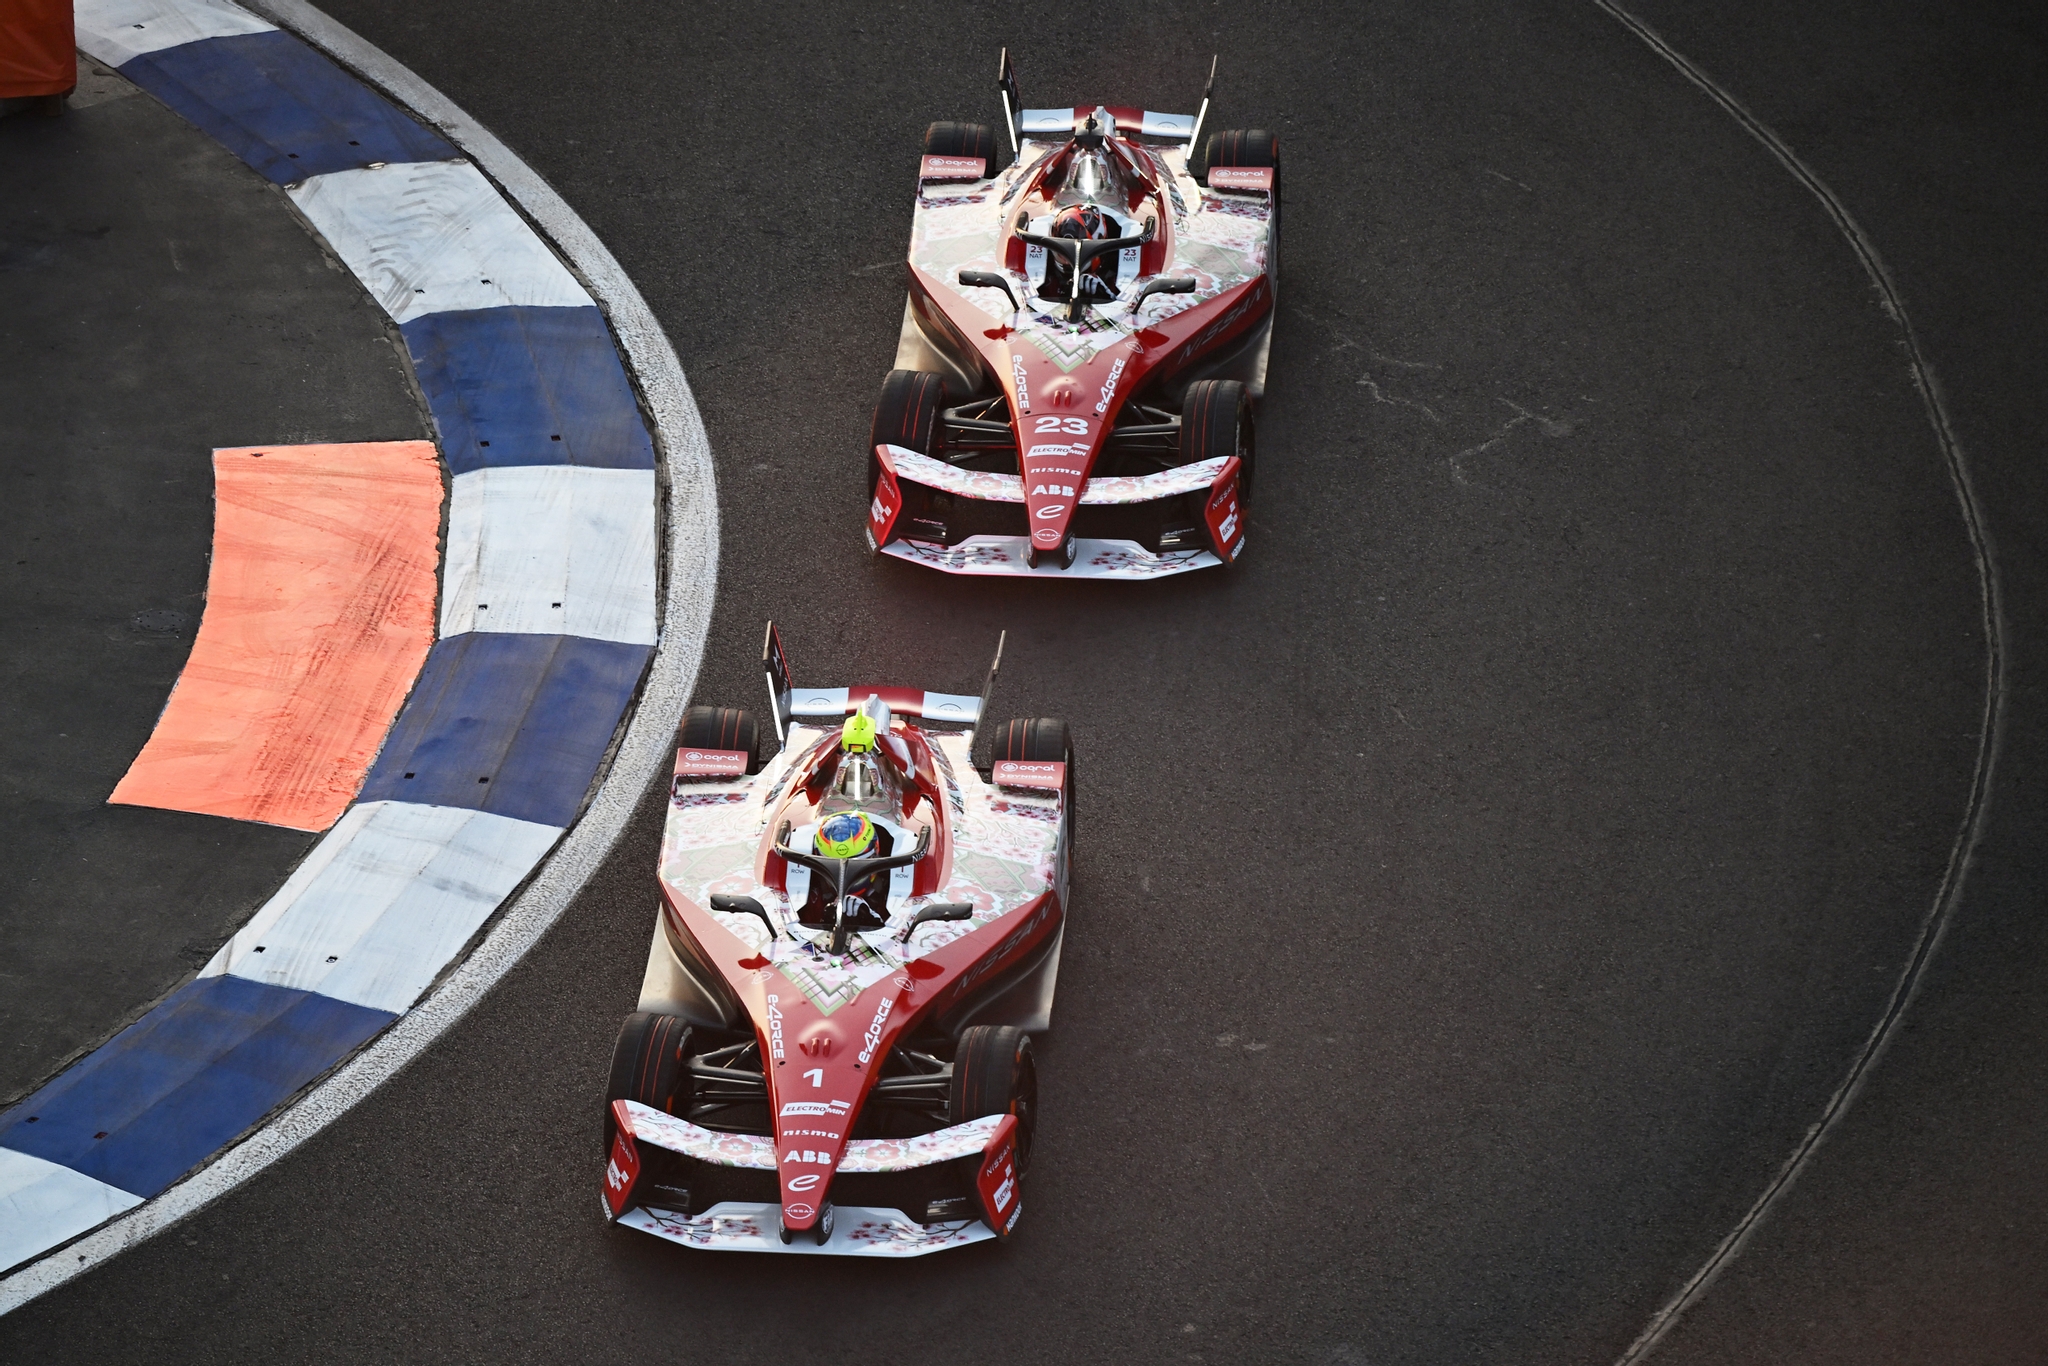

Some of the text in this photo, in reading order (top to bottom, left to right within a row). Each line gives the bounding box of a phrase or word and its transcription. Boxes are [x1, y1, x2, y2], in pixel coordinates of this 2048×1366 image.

[1177, 279, 1267, 365] NISSAN
[1034, 416, 1089, 435] 23
[1030, 467, 1081, 476] nismo
[1031, 484, 1075, 497] ABB
[953, 896, 1054, 997] NISSAN
[803, 1068, 823, 1088] 1
[783, 1129, 839, 1139] nismo
[783, 1150, 832, 1165] ABB
